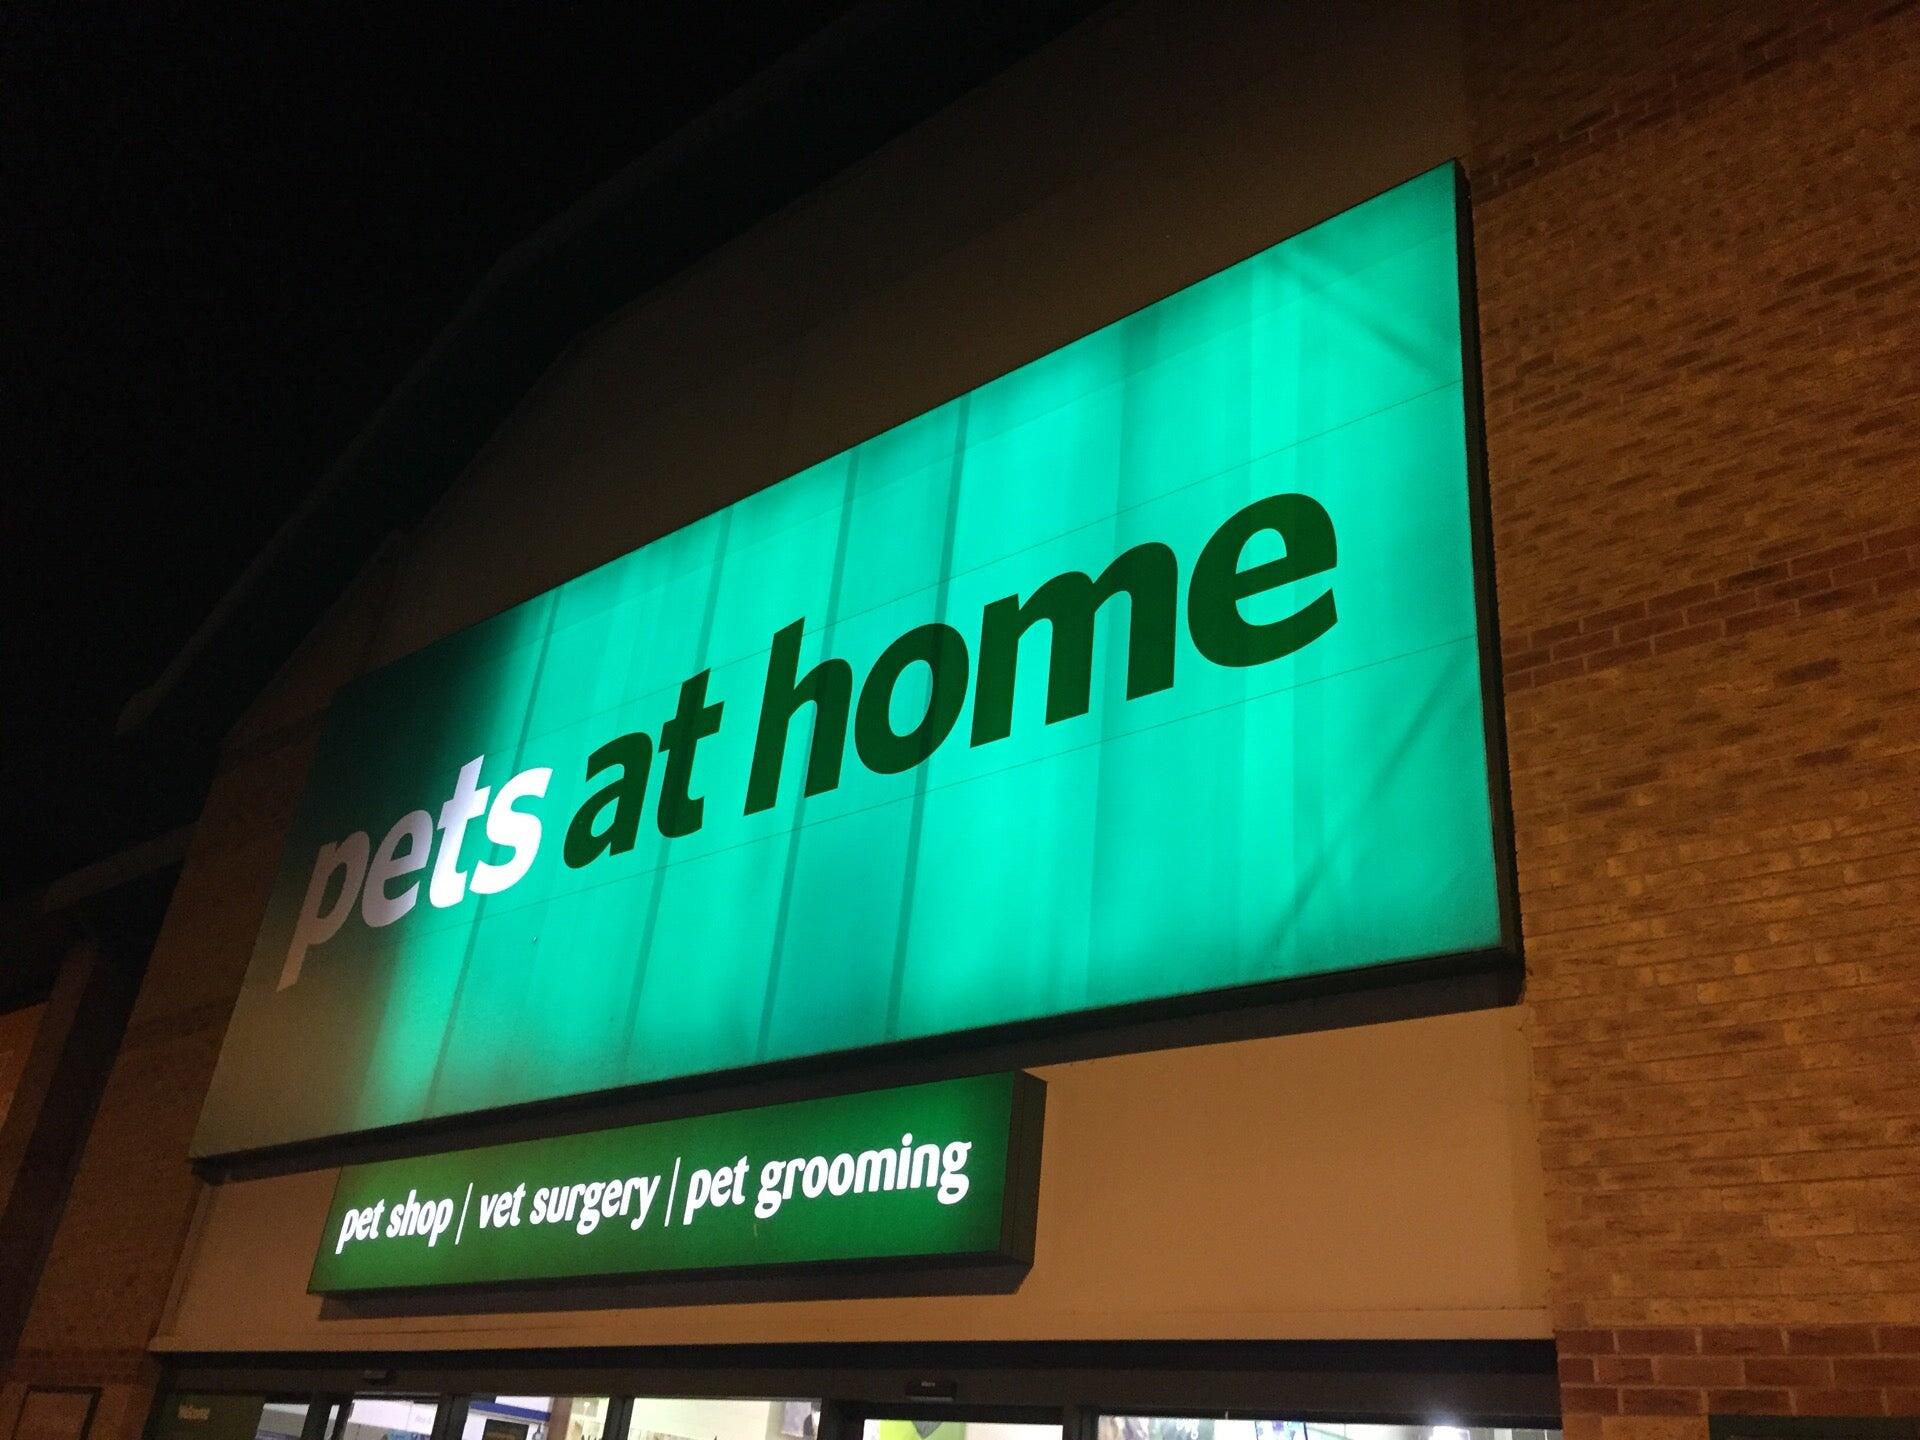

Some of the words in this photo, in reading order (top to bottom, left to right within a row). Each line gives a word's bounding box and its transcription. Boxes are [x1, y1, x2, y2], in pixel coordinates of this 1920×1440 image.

[278, 755, 552, 990] pets
[564, 669, 724, 868] at
[744, 494, 1337, 815] home
[336, 1197, 385, 1254] pet
[386, 1189, 453, 1247] shop
[480, 1183, 526, 1228] vet
[530, 1176, 661, 1236] surgery
[683, 1156, 749, 1225] pet
[755, 1132, 972, 1219] grooming
